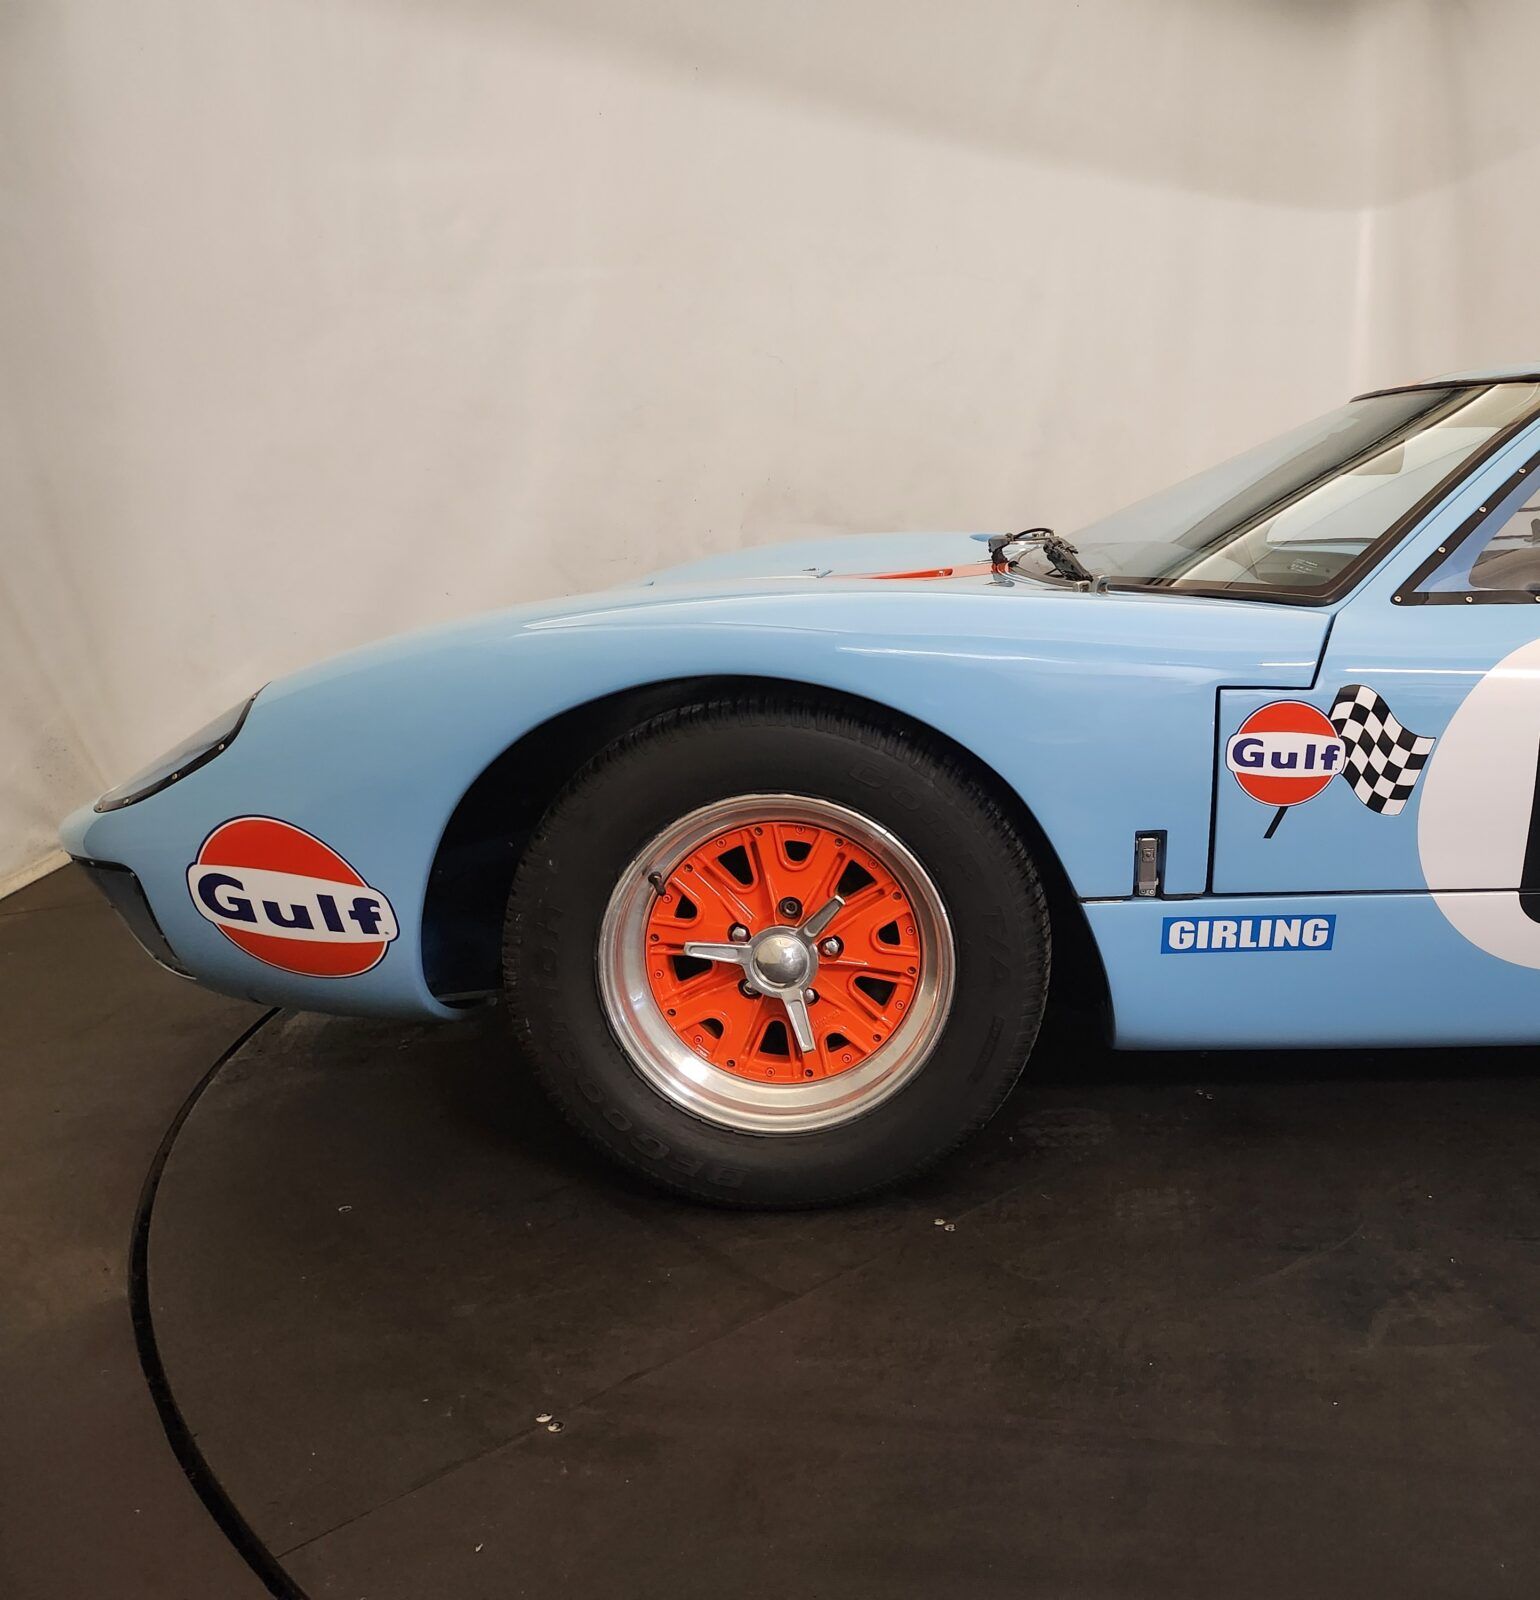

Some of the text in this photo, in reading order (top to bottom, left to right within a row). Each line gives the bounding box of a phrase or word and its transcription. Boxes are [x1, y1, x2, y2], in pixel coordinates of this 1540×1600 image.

[1231, 737, 1341, 771] Gulf
[197, 872, 384, 935] Gulf
[1168, 918, 1330, 950] GIRLING
